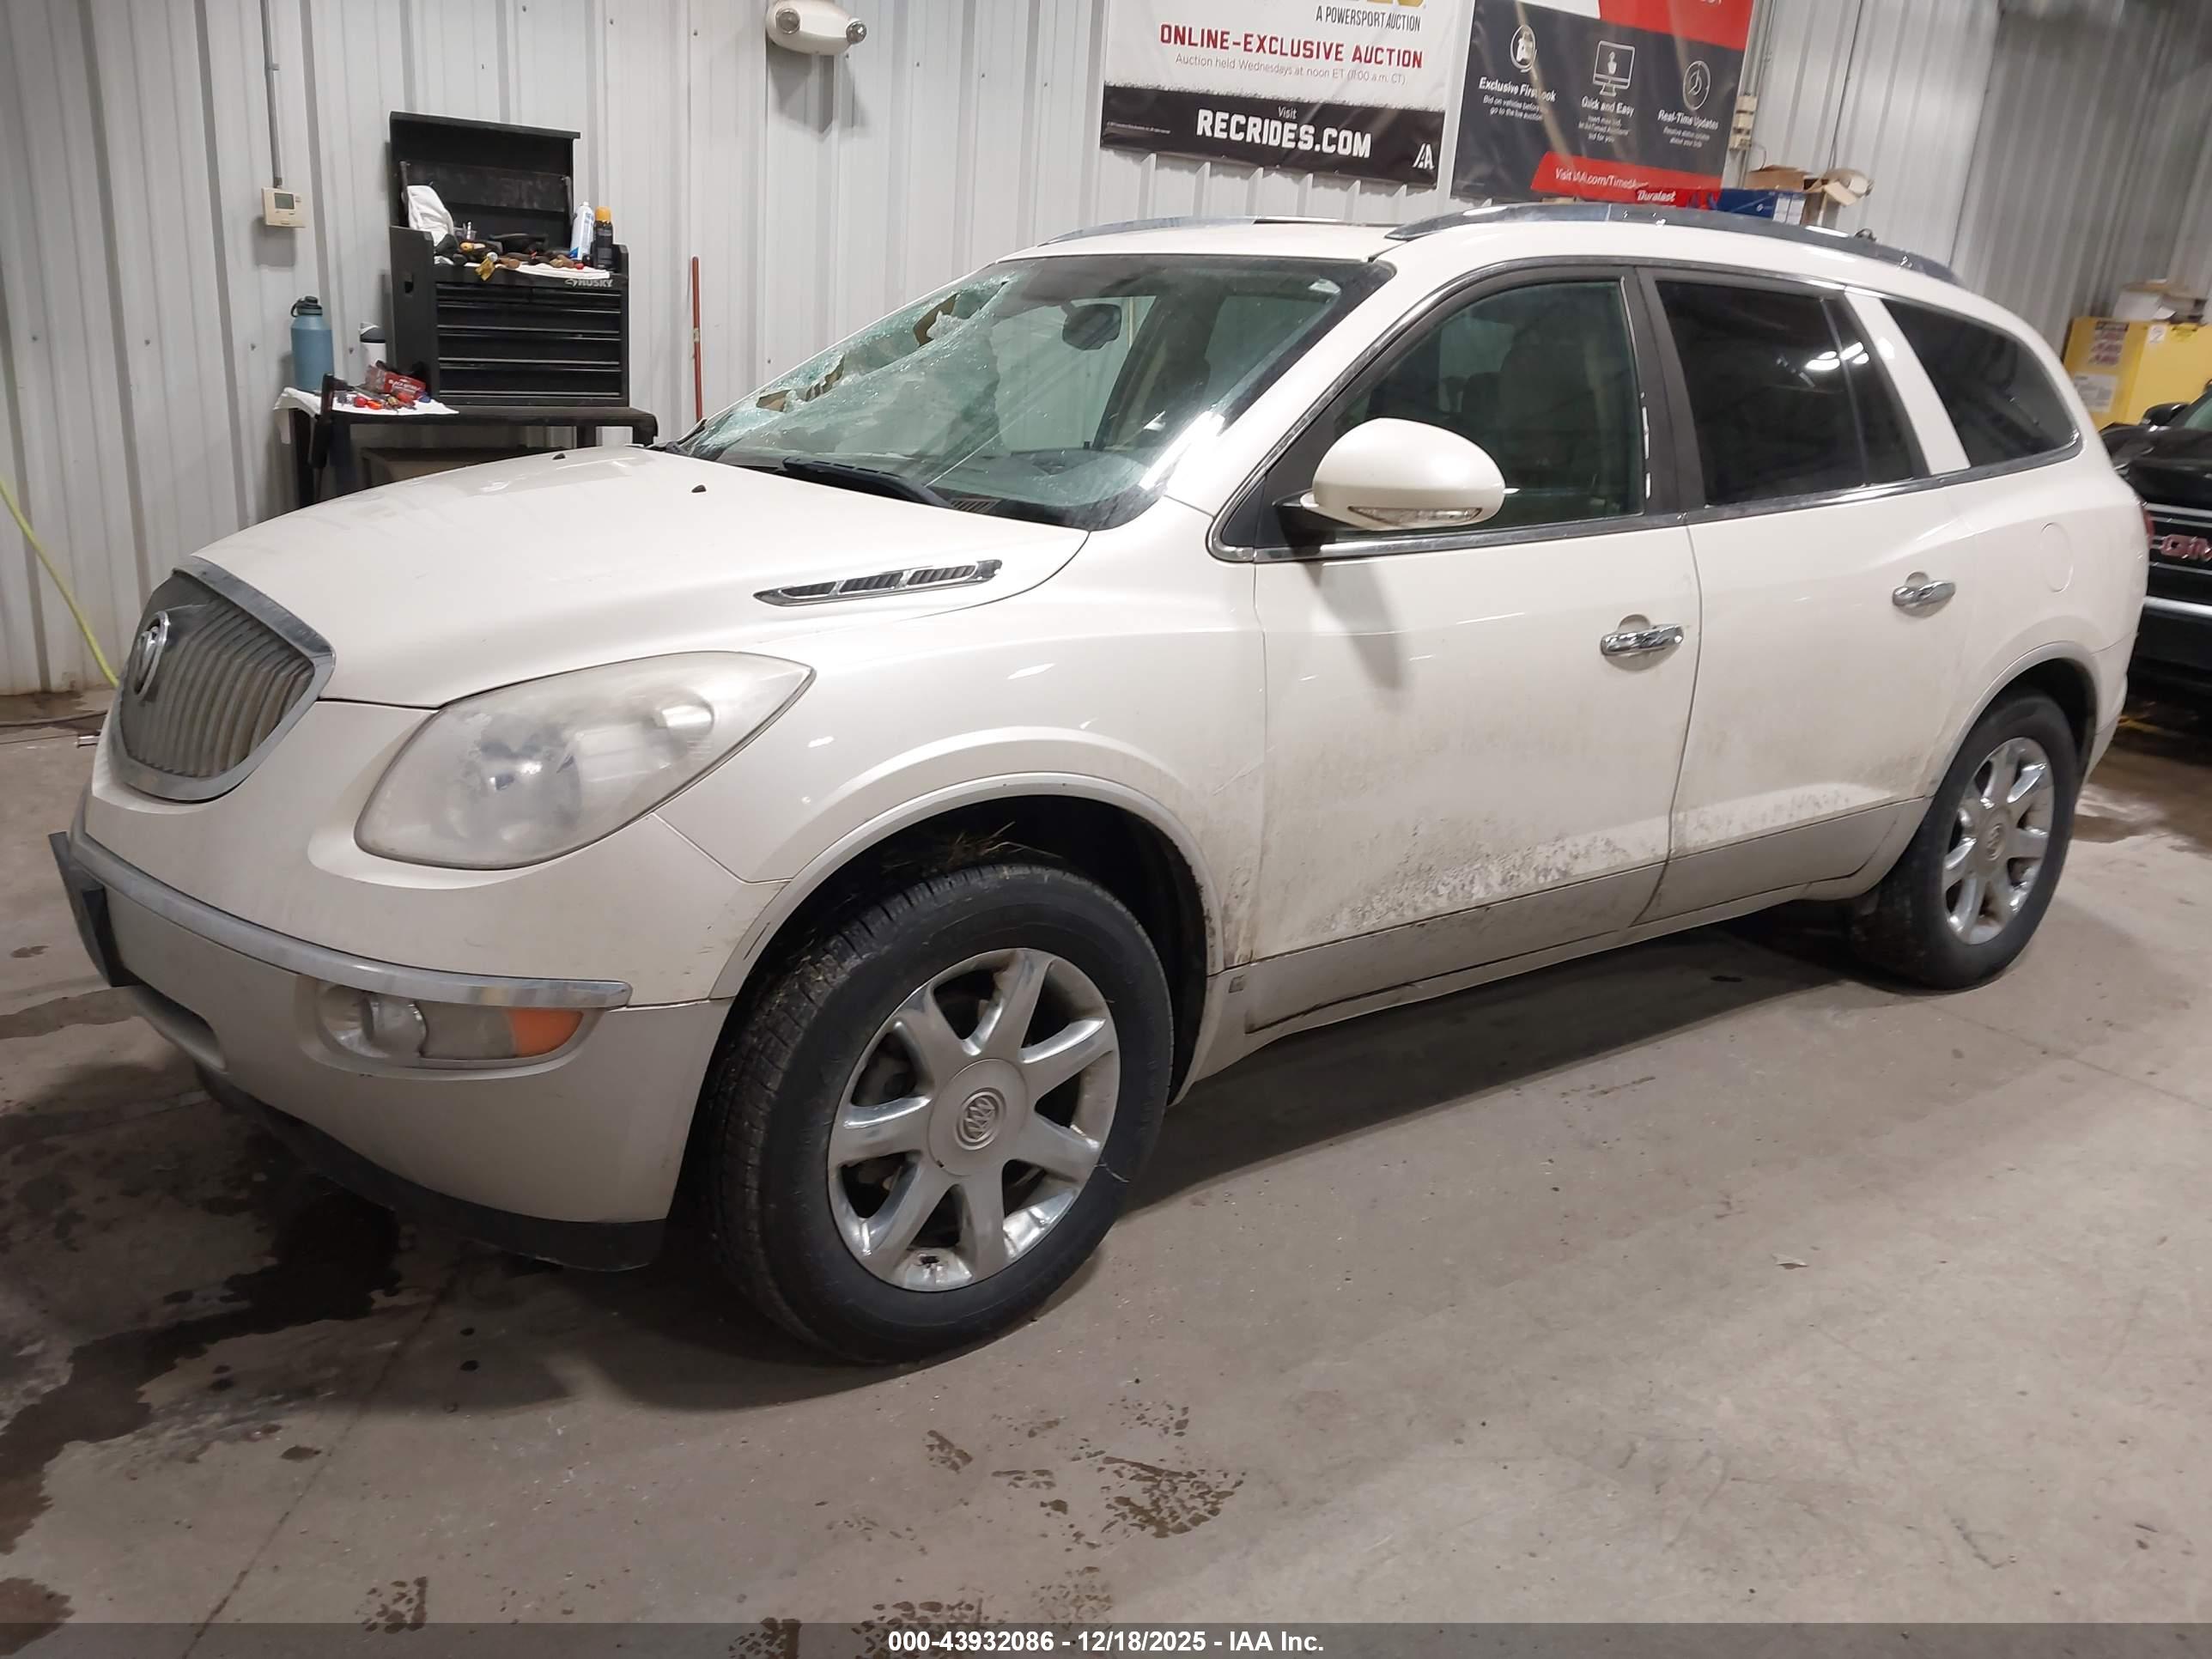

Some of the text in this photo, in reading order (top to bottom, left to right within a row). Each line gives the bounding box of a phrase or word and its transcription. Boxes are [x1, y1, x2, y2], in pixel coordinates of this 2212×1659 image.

[1316, 6, 1421, 32] A POWERSPORT AUCTION
[1160, 24, 1424, 69] ONLINE-EXCLUSIVE AUCTION
[1176, 53, 1213, 68] Auction
[1215, 58, 1236, 70] held
[1238, 59, 1292, 77] Wednesdays
[1294, 67, 1304, 76] at
[1307, 69, 1329, 78] noon
[1333, 69, 1344, 79] ET
[1479, 76, 1519, 94] Exclusive
[1278, 106, 1297, 119] Visit
[1581, 95, 1635, 118] Quick and Easy
[1657, 109, 1693, 125] Real-Time
[1196, 108, 1372, 159] RECRIDES.COM
[1555, 167, 1571, 181] Visit
[577, 278, 614, 288] HUSKY
